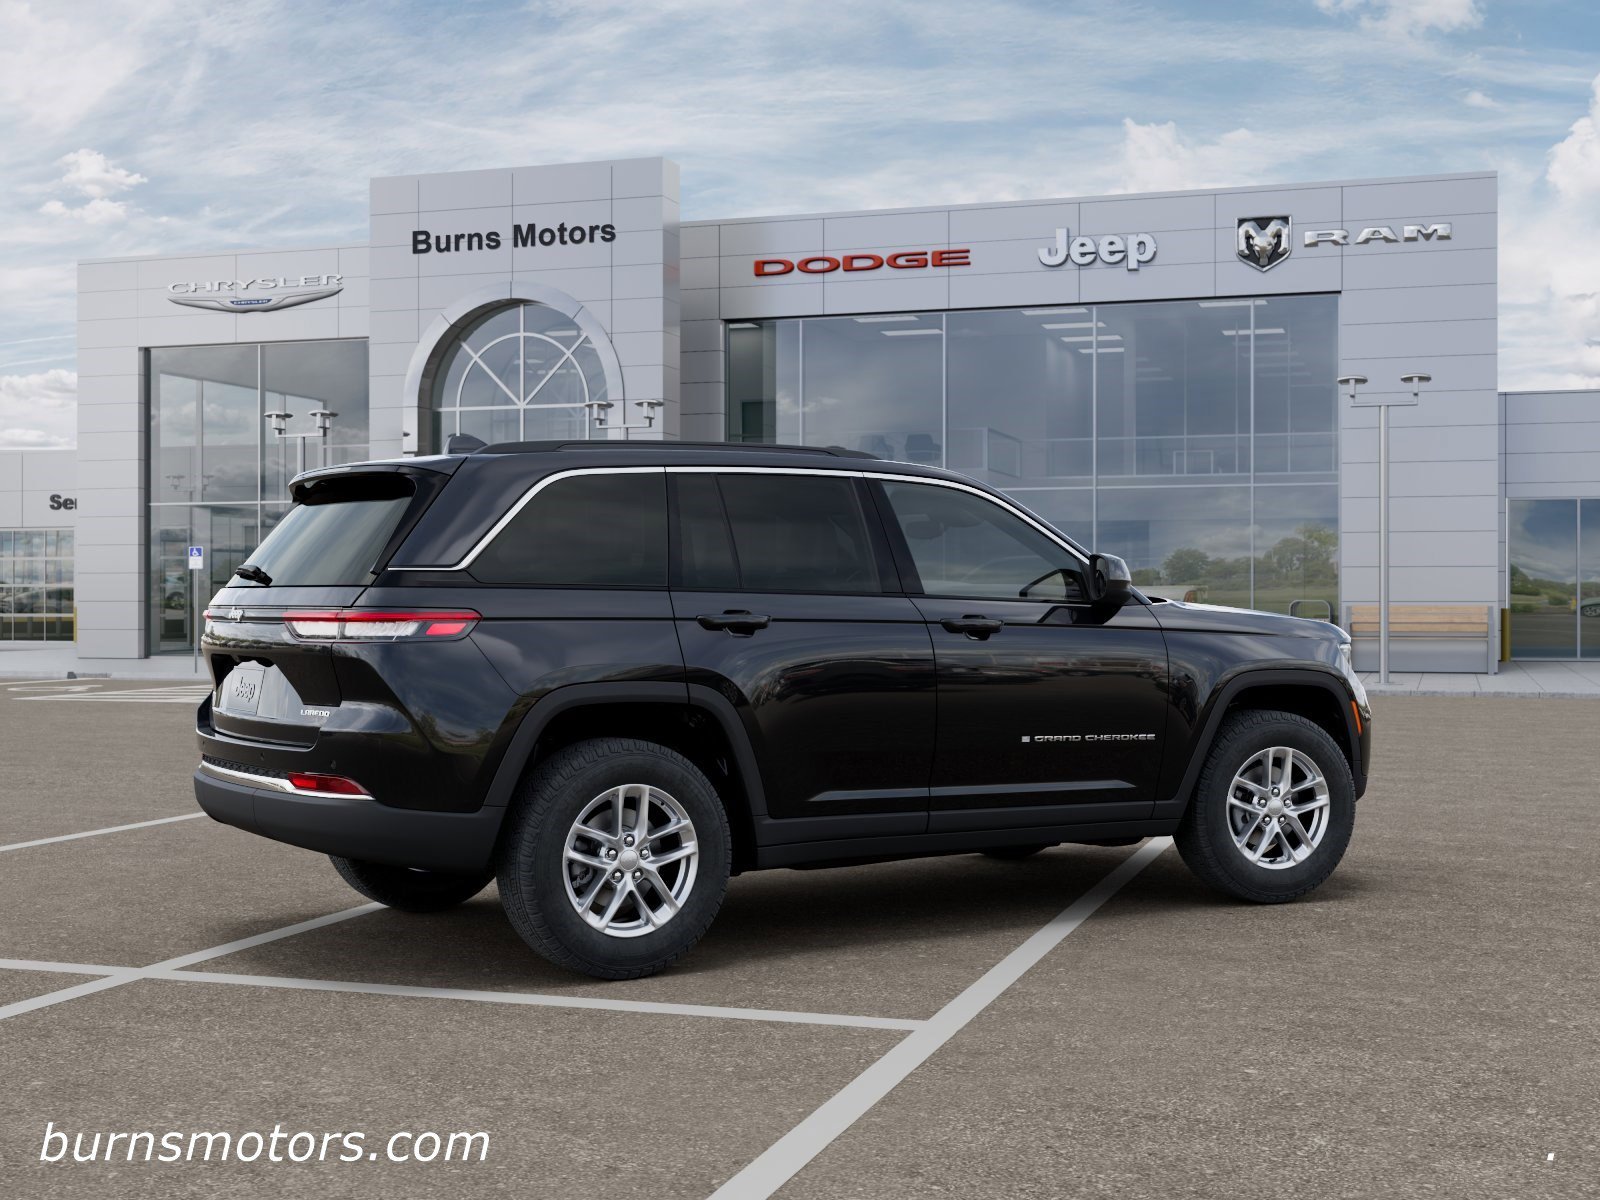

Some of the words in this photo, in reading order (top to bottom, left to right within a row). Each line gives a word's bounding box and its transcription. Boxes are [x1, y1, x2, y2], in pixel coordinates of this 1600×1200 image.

[412, 230, 501, 254] Burns
[513, 222, 616, 248] Motors
[1038, 227, 1157, 271] Jeep
[1304, 223, 1452, 248] RAM
[754, 249, 971, 276] DODGE
[168, 274, 344, 293] CHRYSLER
[235, 676, 256, 703] Jeep
[300, 709, 330, 717] LAREDO
